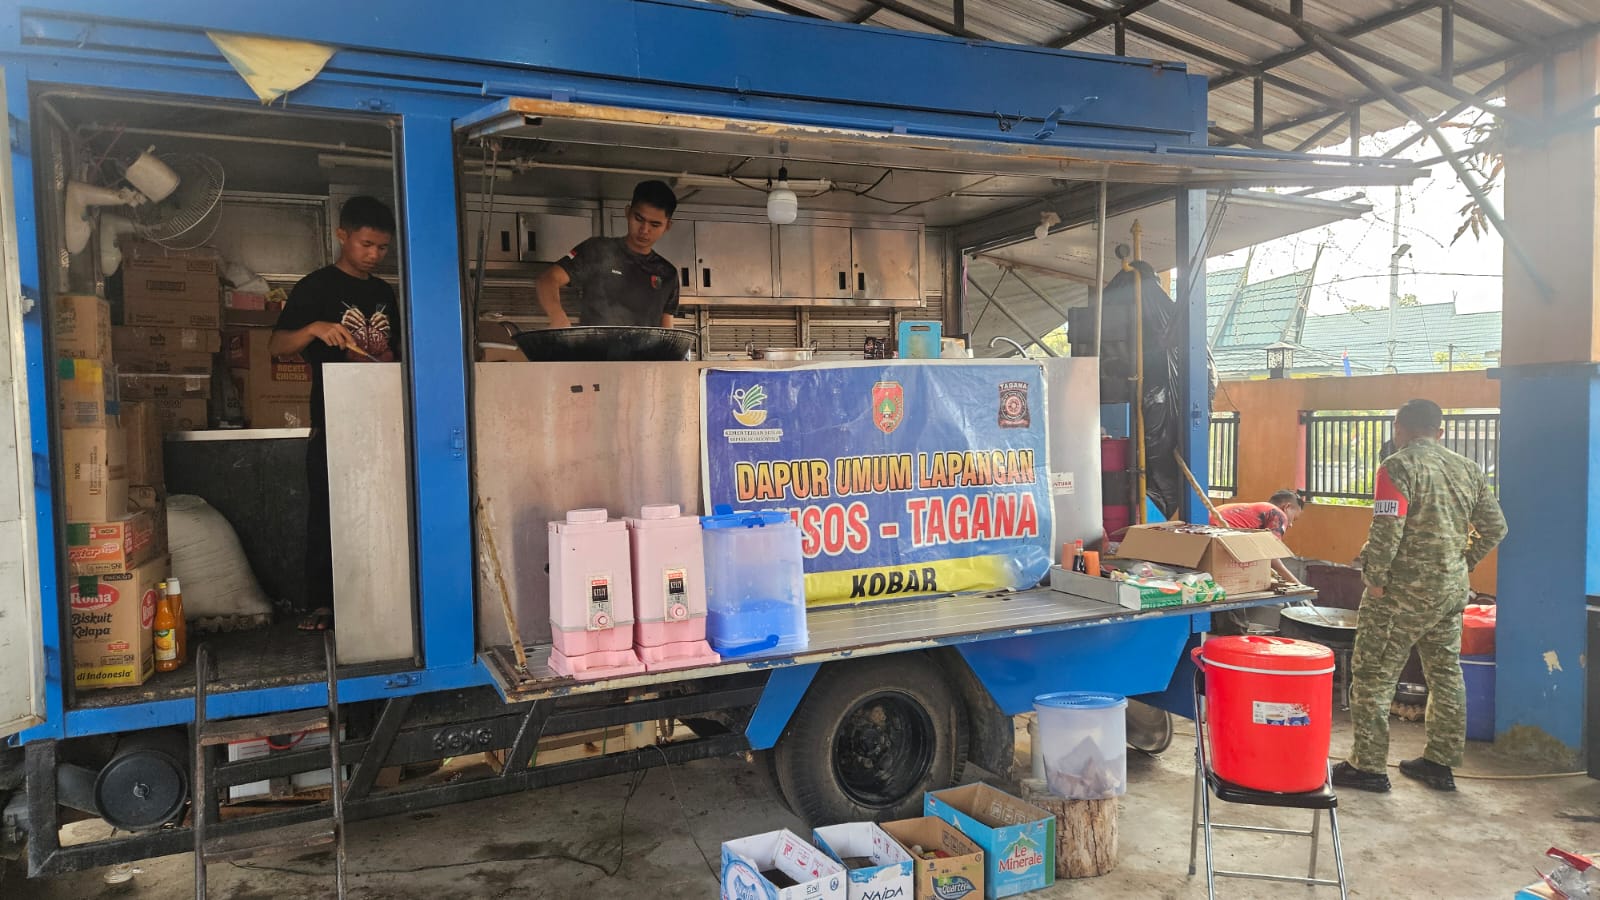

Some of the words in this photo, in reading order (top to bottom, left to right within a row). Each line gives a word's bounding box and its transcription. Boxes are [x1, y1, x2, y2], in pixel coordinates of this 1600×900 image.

[735, 459, 830, 501] DAPUR
[836, 454, 912, 495] UMUM
[919, 449, 1035, 488] LAPANGAN
[882, 525, 897, 535] -
[908, 494, 1037, 545] TAGANA
[850, 567, 937, 598] KOBAR
[72, 612, 112, 625] Biskuit
[72, 626, 111, 639] Kelapa
[86, 670, 131, 680] Indonesia
[1015, 845, 1027, 858] Le
[998, 852, 1043, 873] Minerale
